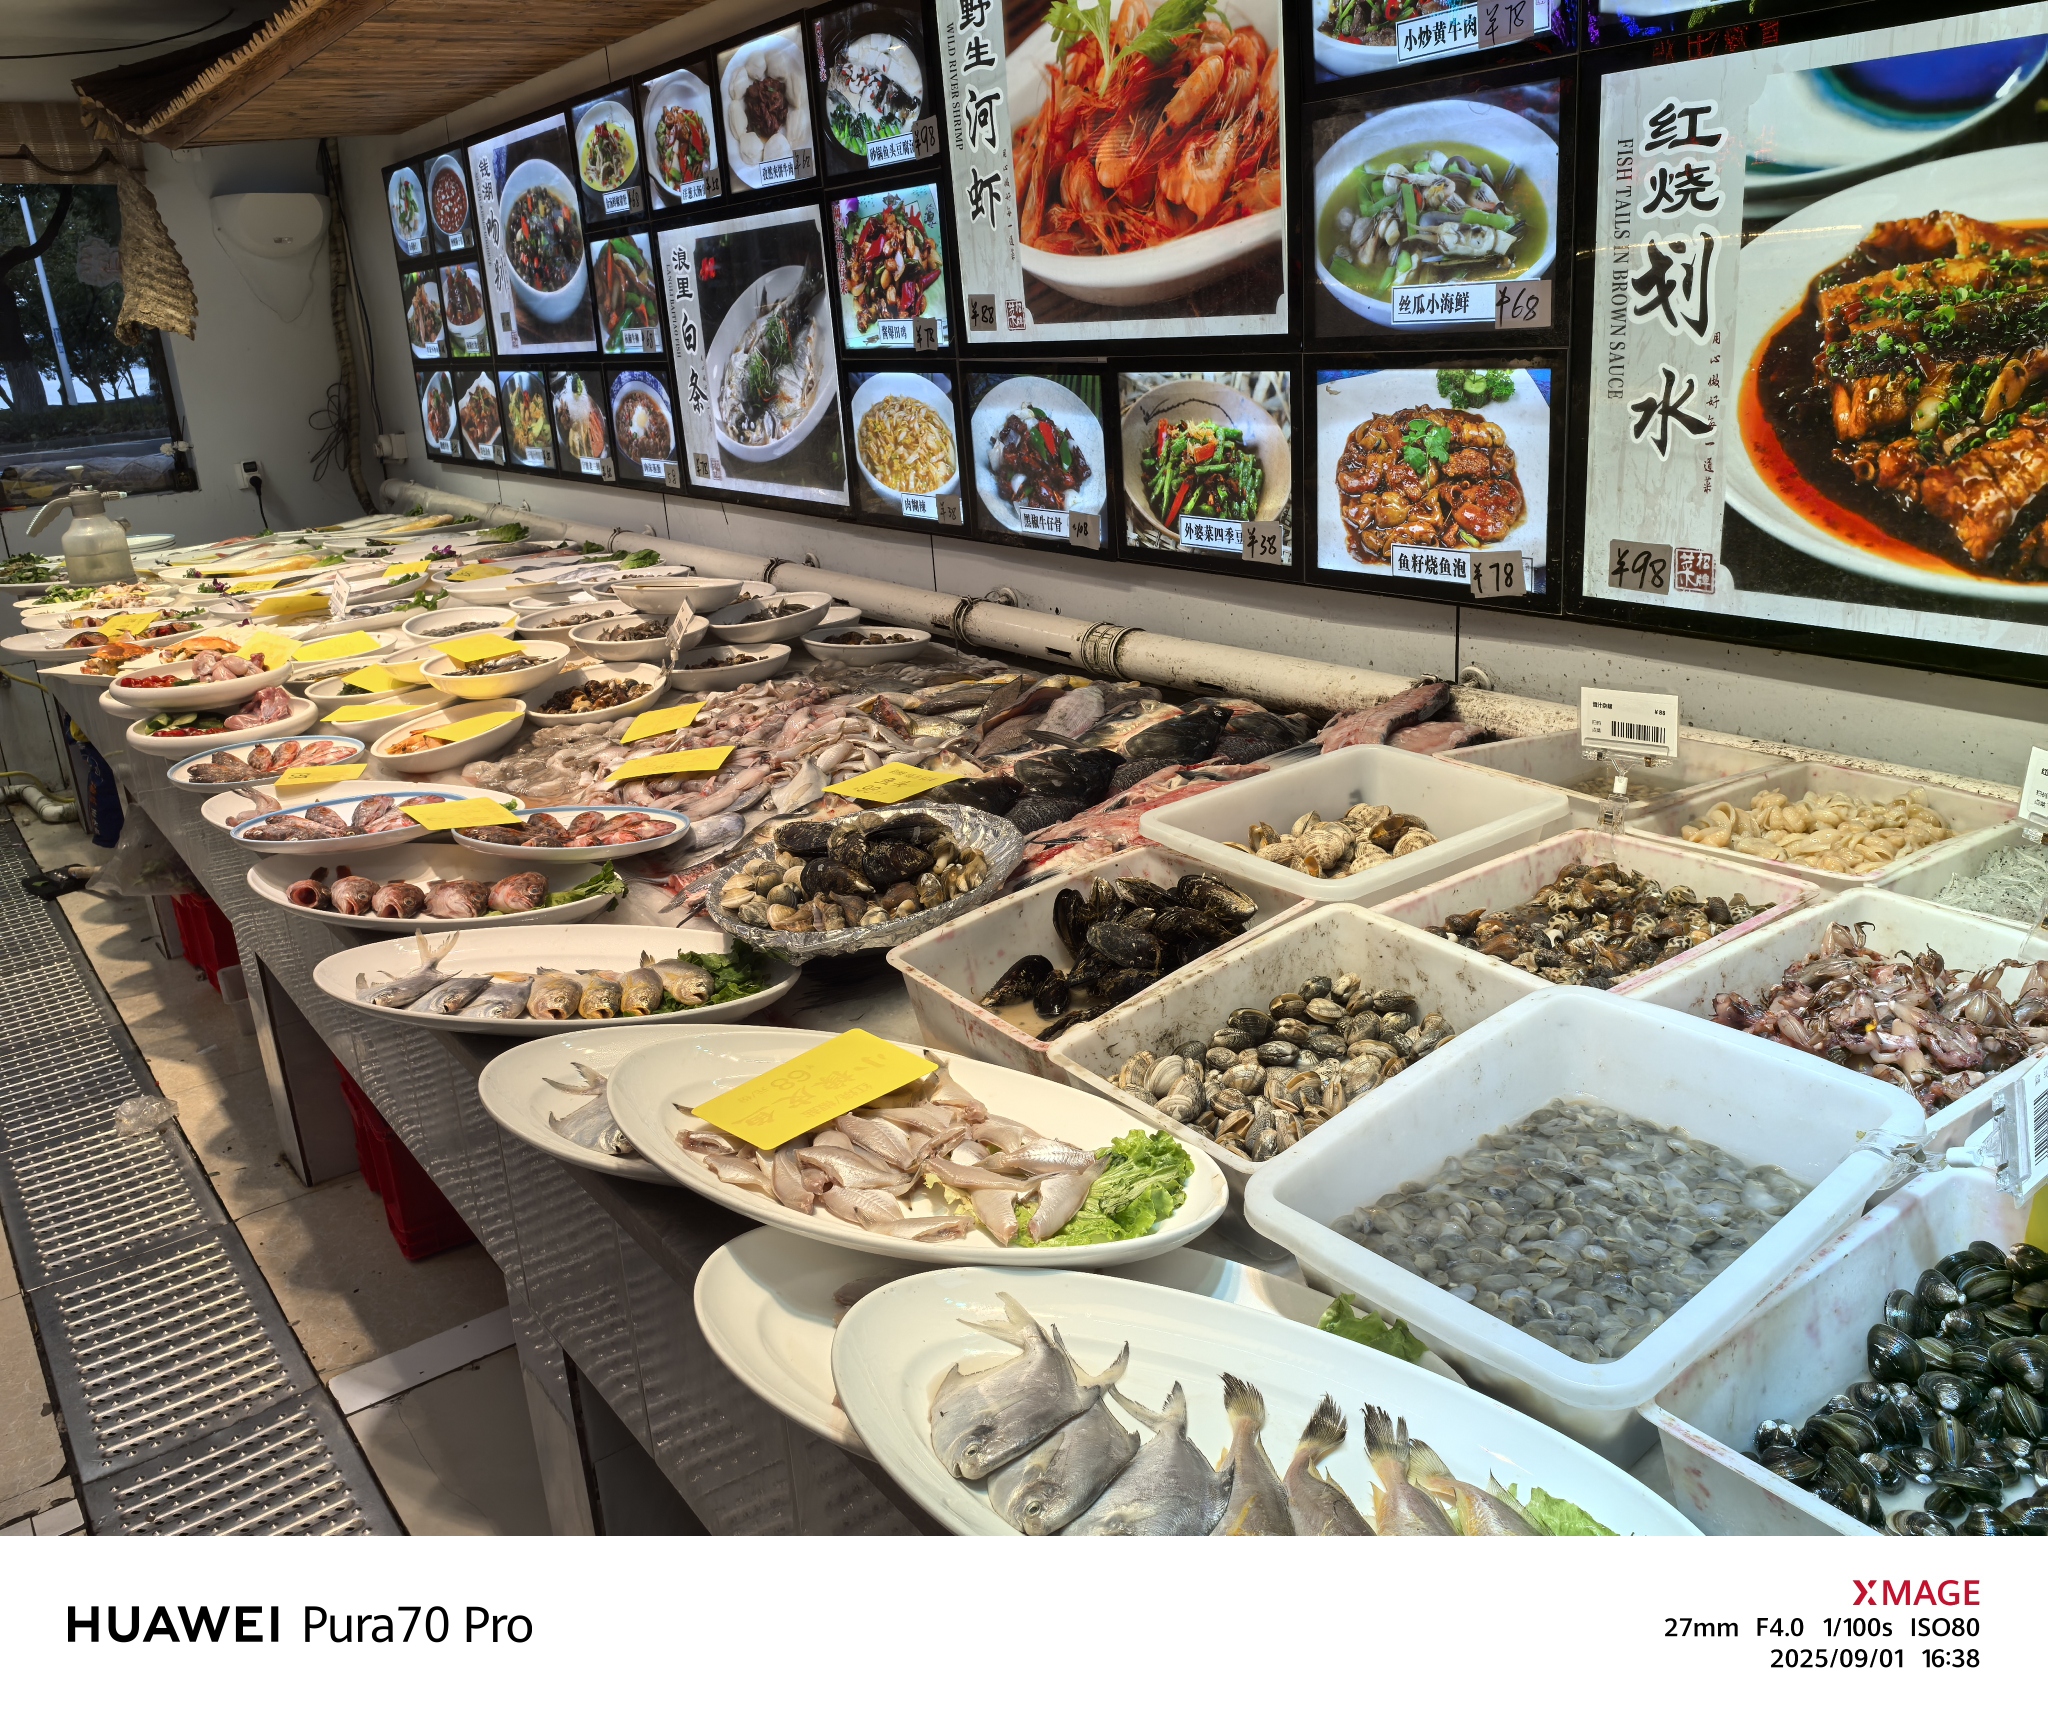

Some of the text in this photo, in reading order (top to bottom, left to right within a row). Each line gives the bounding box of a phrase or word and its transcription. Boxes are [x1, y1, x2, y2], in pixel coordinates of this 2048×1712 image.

[1403, 13, 1478, 52] 小炒黄牛肉
[946, 22, 964, 151] WILD RIVER SHRIMP
[959, 0, 1002, 229] 野生河虾
[1607, 138, 1634, 400] FISH TAILS IN BROWN SAUCE
[1630, 101, 1723, 458] 红烧划水
[1398, 291, 1470, 316] 丝瓜小海鲜
[1495, 286, 1540, 327] ¥68
[671, 247, 709, 415] 浪里白条
[1023, 513, 1063, 533] 黑椒牛仔骨
[1397, 552, 1467, 579] 鱼籽烧鱼泡
[1472, 562, 1514, 594] ¥78
[1611, 547, 1667, 589] ¥98
